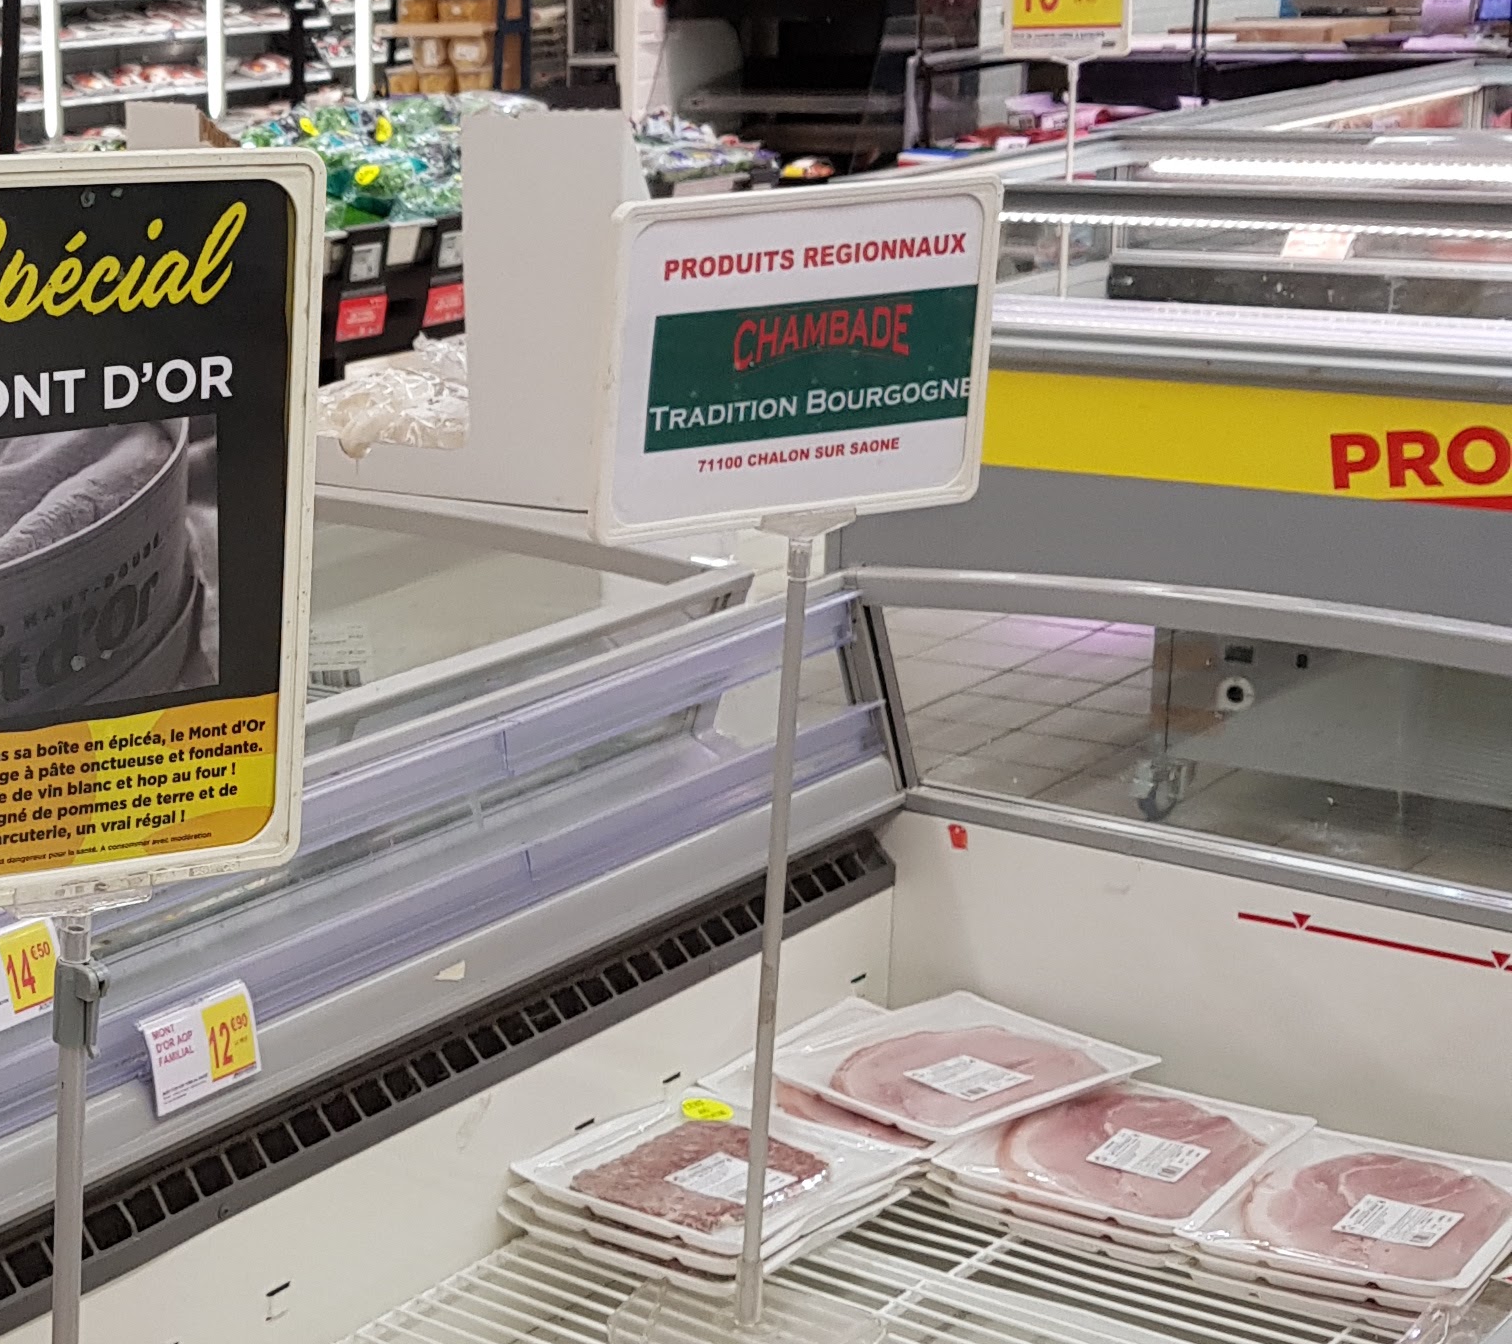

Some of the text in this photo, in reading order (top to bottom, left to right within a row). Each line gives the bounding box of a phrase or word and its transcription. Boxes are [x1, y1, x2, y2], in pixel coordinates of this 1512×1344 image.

[663, 233, 967, 281] PRODUITS REGIONNAUX
[732, 303, 913, 372] CHAMBADE
[103, 355, 233, 408] D'OR
[698, 438, 900, 473] 71100 CHALON SUR SAONE
[1330, 426, 1512, 490] PRO
[14, 748, 32, 760] sa
[37, 740, 79, 757] boîte
[84, 740, 104, 752] en
[109, 731, 166, 750] épicéa,
[170, 729, 185, 743] le
[189, 723, 227, 740] Mont
[231, 719, 266, 735] d'Or
[24, 766, 34, 780] à
[39, 762, 76, 781] pâte
[80, 754, 164, 774] onctueuse
[168, 750, 185, 763] et
[189, 741, 263, 761] fondante.
[12, 788, 33, 802] de
[38, 784, 63, 799] vin
[68, 780, 111, 796] blanc
[116, 776, 133, 789] et
[137, 774, 168, 787] hop
[172, 771, 191, 783] au
[195, 765, 227, 780] four
[32, 806, 53, 821] de
[57, 798, 127, 821] pommes
[132, 794, 152, 808] de
[156, 791, 194, 805] terre
[198, 786, 215, 800] et
[219, 783, 238, 797] de
[76, 823, 96, 836] un
[101, 817, 131, 833] vrai
[135, 811, 176, 830] régal
[159, 1047, 194, 1067] FAMILIAL
